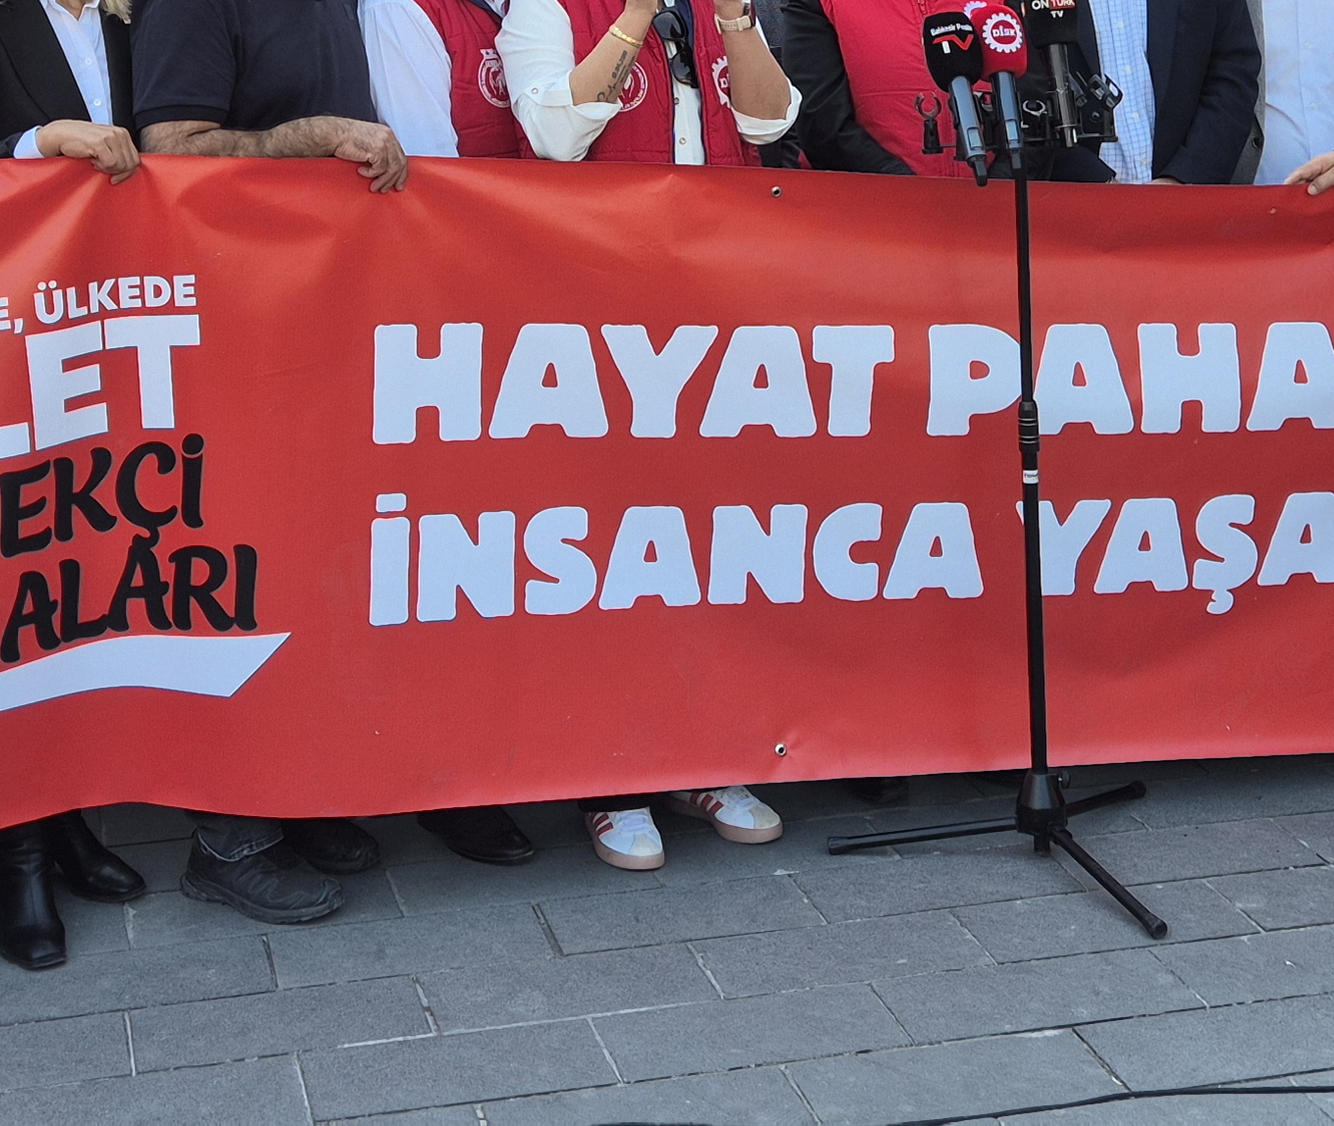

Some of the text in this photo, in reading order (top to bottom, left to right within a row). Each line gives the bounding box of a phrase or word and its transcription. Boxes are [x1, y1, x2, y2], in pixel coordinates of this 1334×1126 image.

[1050, 10, 1064, 19] TV
[33, 274, 198, 326] ÜLKEDE
[372, 322, 895, 444] HAYAT
[369, 493, 985, 627] İNSANCA
